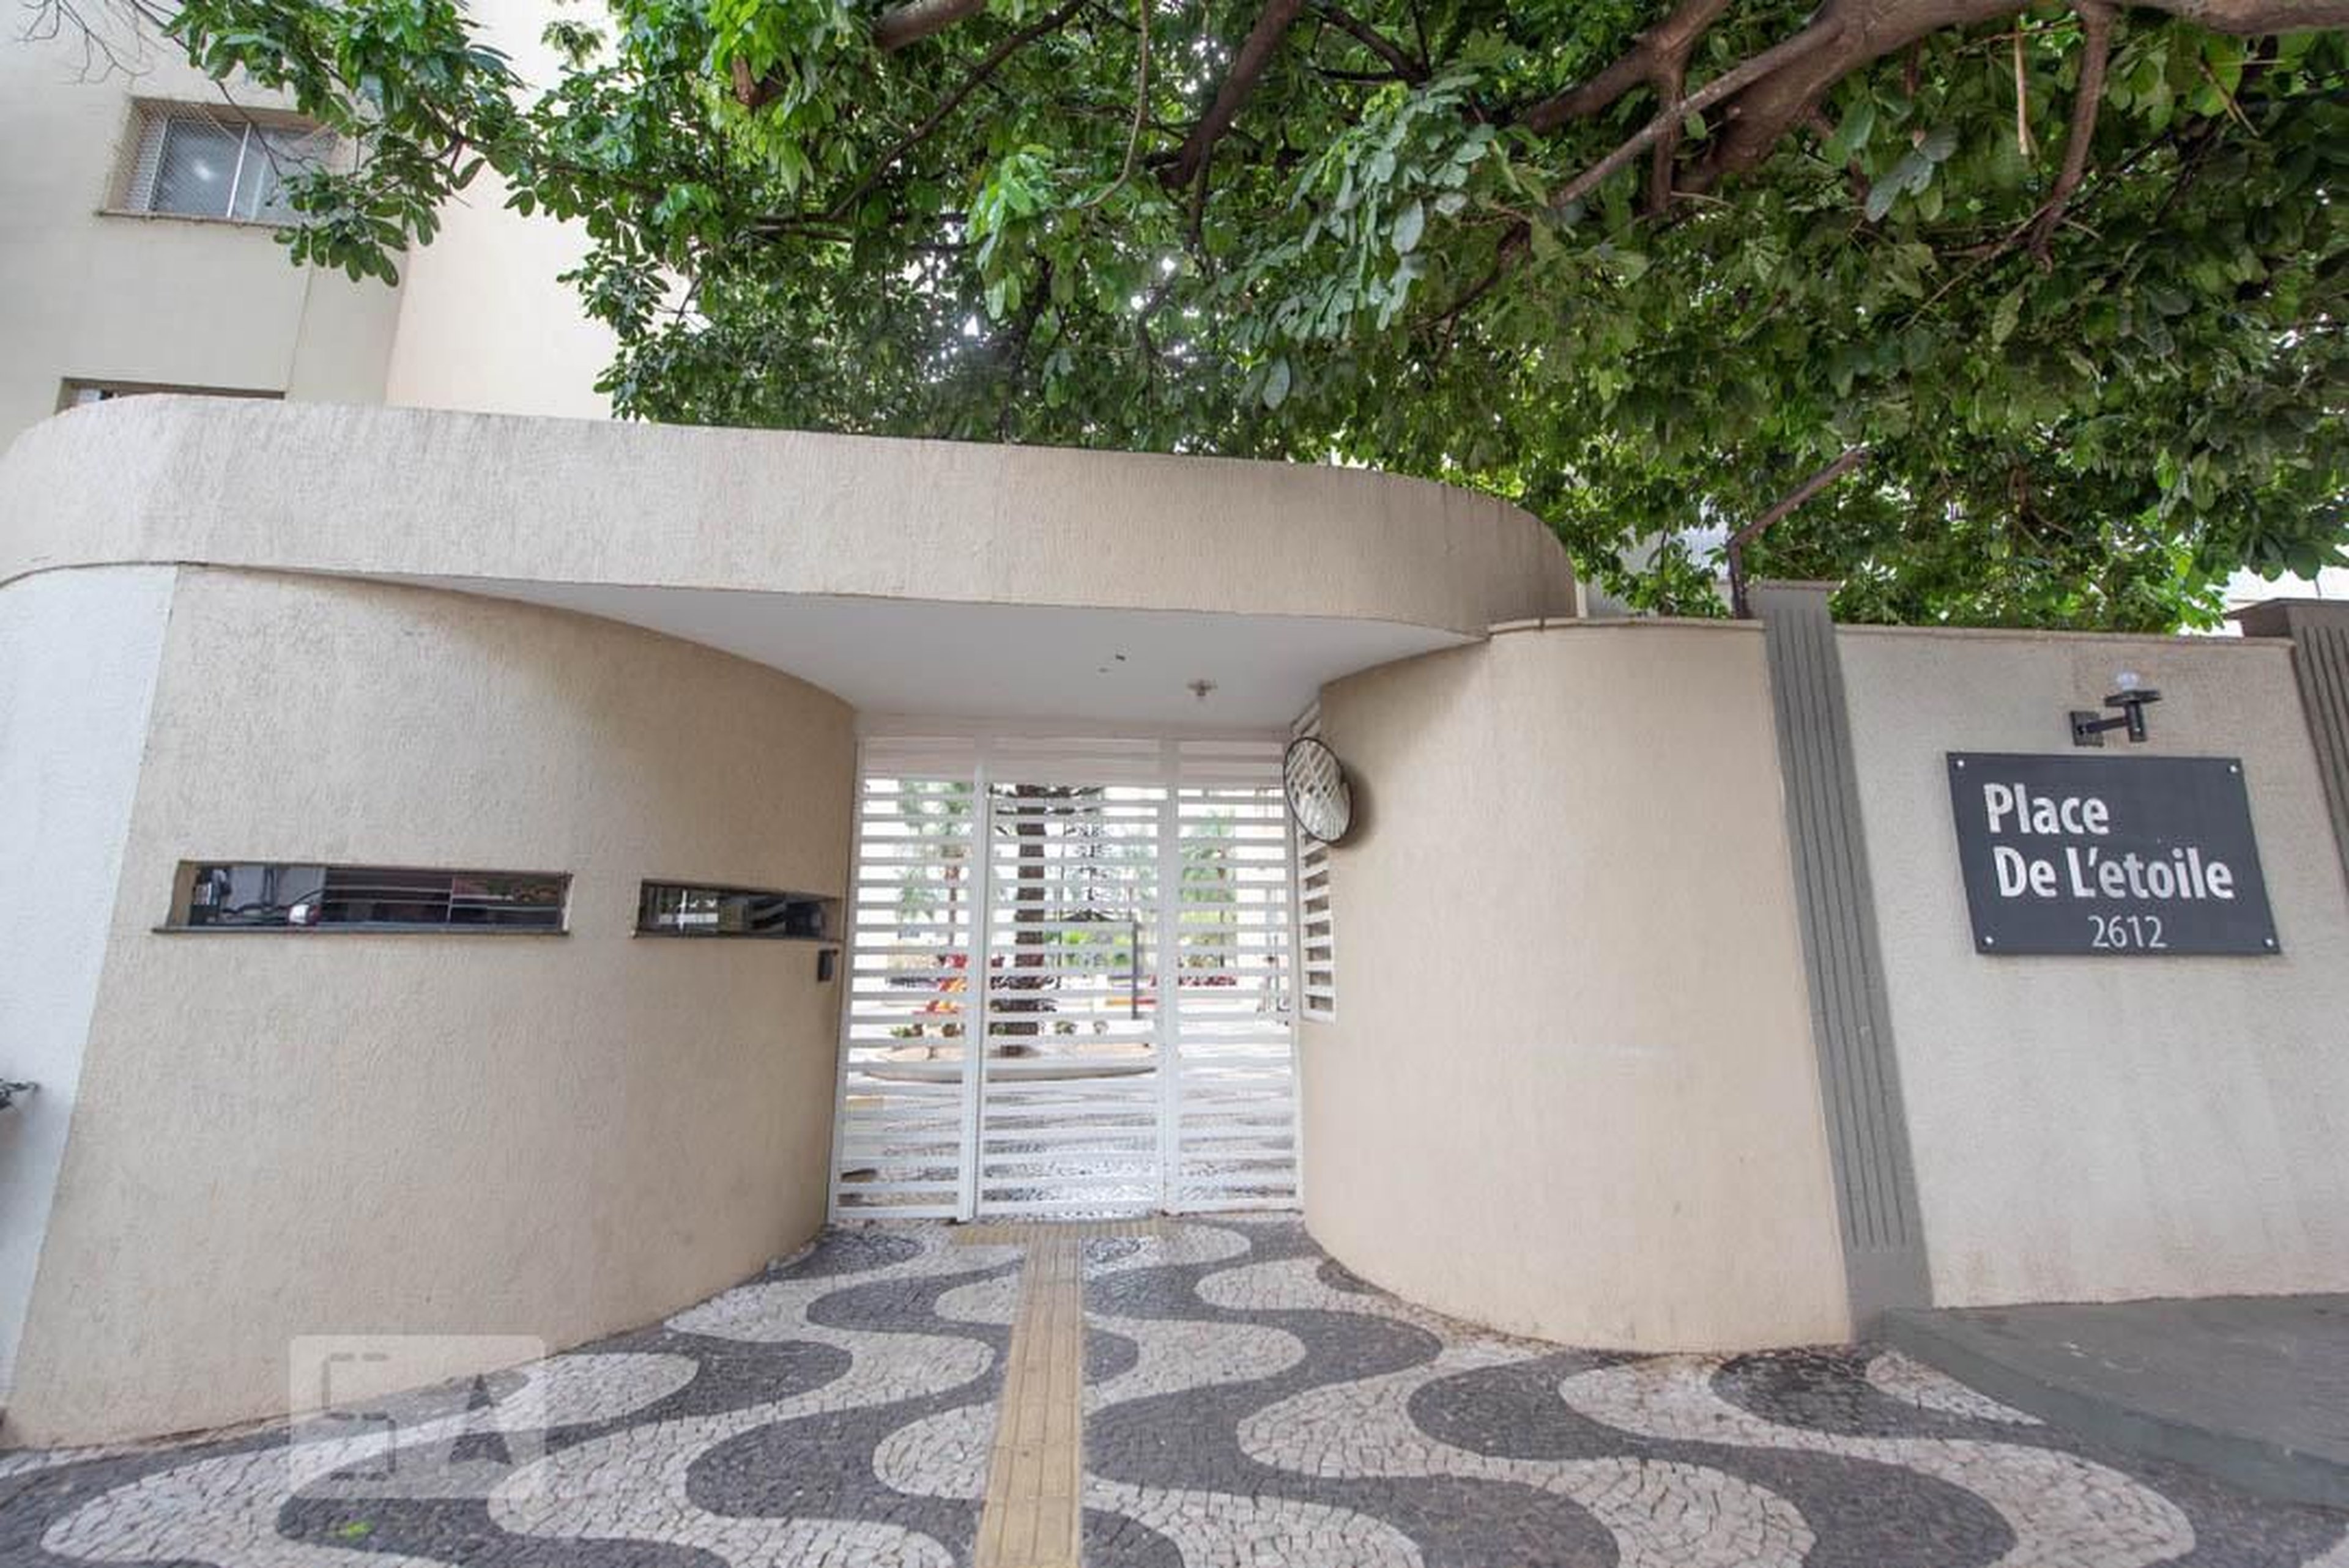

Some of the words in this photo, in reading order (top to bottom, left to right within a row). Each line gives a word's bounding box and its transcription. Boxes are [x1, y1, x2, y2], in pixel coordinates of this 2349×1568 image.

[1984, 783, 2110, 835] Place
[1994, 846, 2057, 897] De
[2065, 847, 2235, 899] L'etoile
[2088, 915, 2167, 948] 2612
